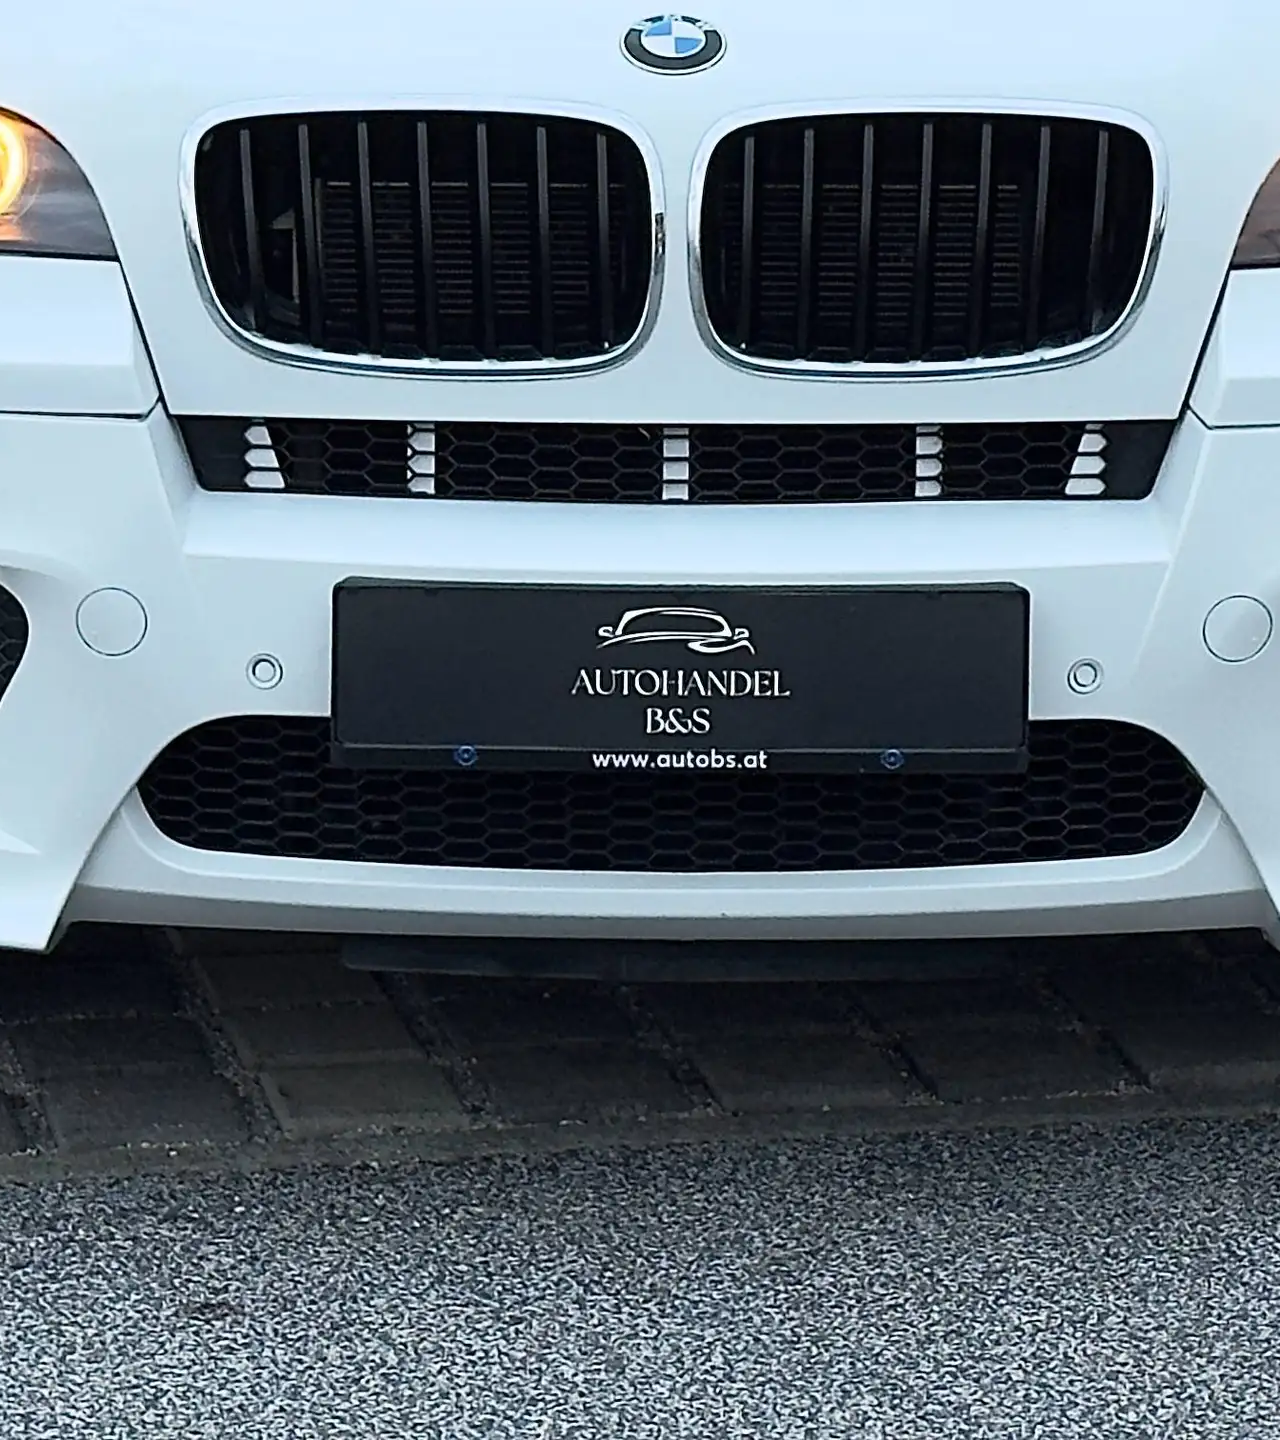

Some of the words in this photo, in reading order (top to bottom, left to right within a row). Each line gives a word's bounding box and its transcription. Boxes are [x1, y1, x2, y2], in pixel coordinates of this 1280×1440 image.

[571, 669, 791, 696] AUTOHANDEL
[646, 707, 711, 734] B&S
[592, 748, 768, 769] www.autobs.at
